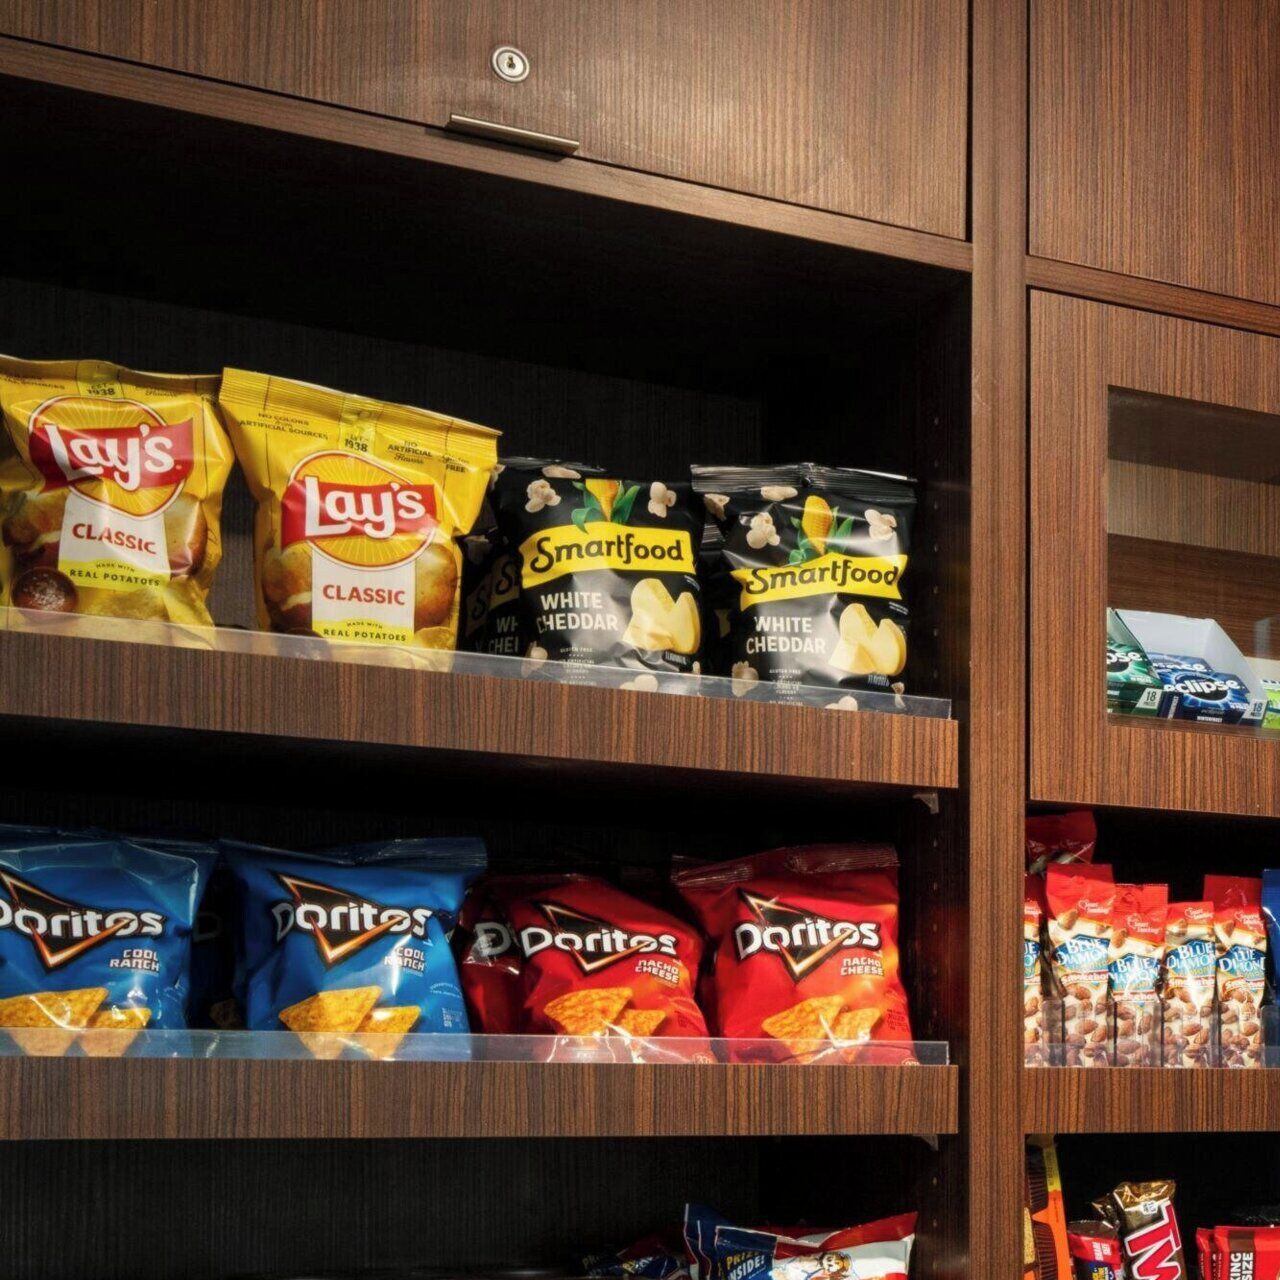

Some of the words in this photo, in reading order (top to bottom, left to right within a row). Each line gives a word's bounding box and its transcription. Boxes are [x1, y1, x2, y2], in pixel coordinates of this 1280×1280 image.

[345, 440, 368, 452] 1938
[44, 424, 176, 491] Lay's
[305, 475, 426, 538] Lay's
[72, 523, 156, 555] CLASSIC
[529, 531, 684, 574] Smartfood
[70, 568, 98, 580] REAL
[102, 573, 160, 587] POTATOES
[745, 558, 898, 596] Smartfood
[322, 584, 405, 605] CLASSIC
[541, 592, 602, 611] WHITE
[537, 613, 618, 634] CHEDDAR
[754, 616, 812, 634] WHITE
[323, 628, 350, 638] REAL
[354, 630, 406, 641] POTATOES
[746, 636, 826, 655] CHEDDAR
[1145, 690, 1156, 701] 18
[1163, 677, 1240, 697] eclipse
[520, 922, 677, 958] Doritos
[735, 918, 880, 959] Doritos
[123, 949, 159, 961] COOL
[843, 958, 883, 967] NACHO
[109, 959, 160, 971] RANCH
[635, 965, 679, 984] CHEESE
[841, 966, 883, 976] CHEESE
